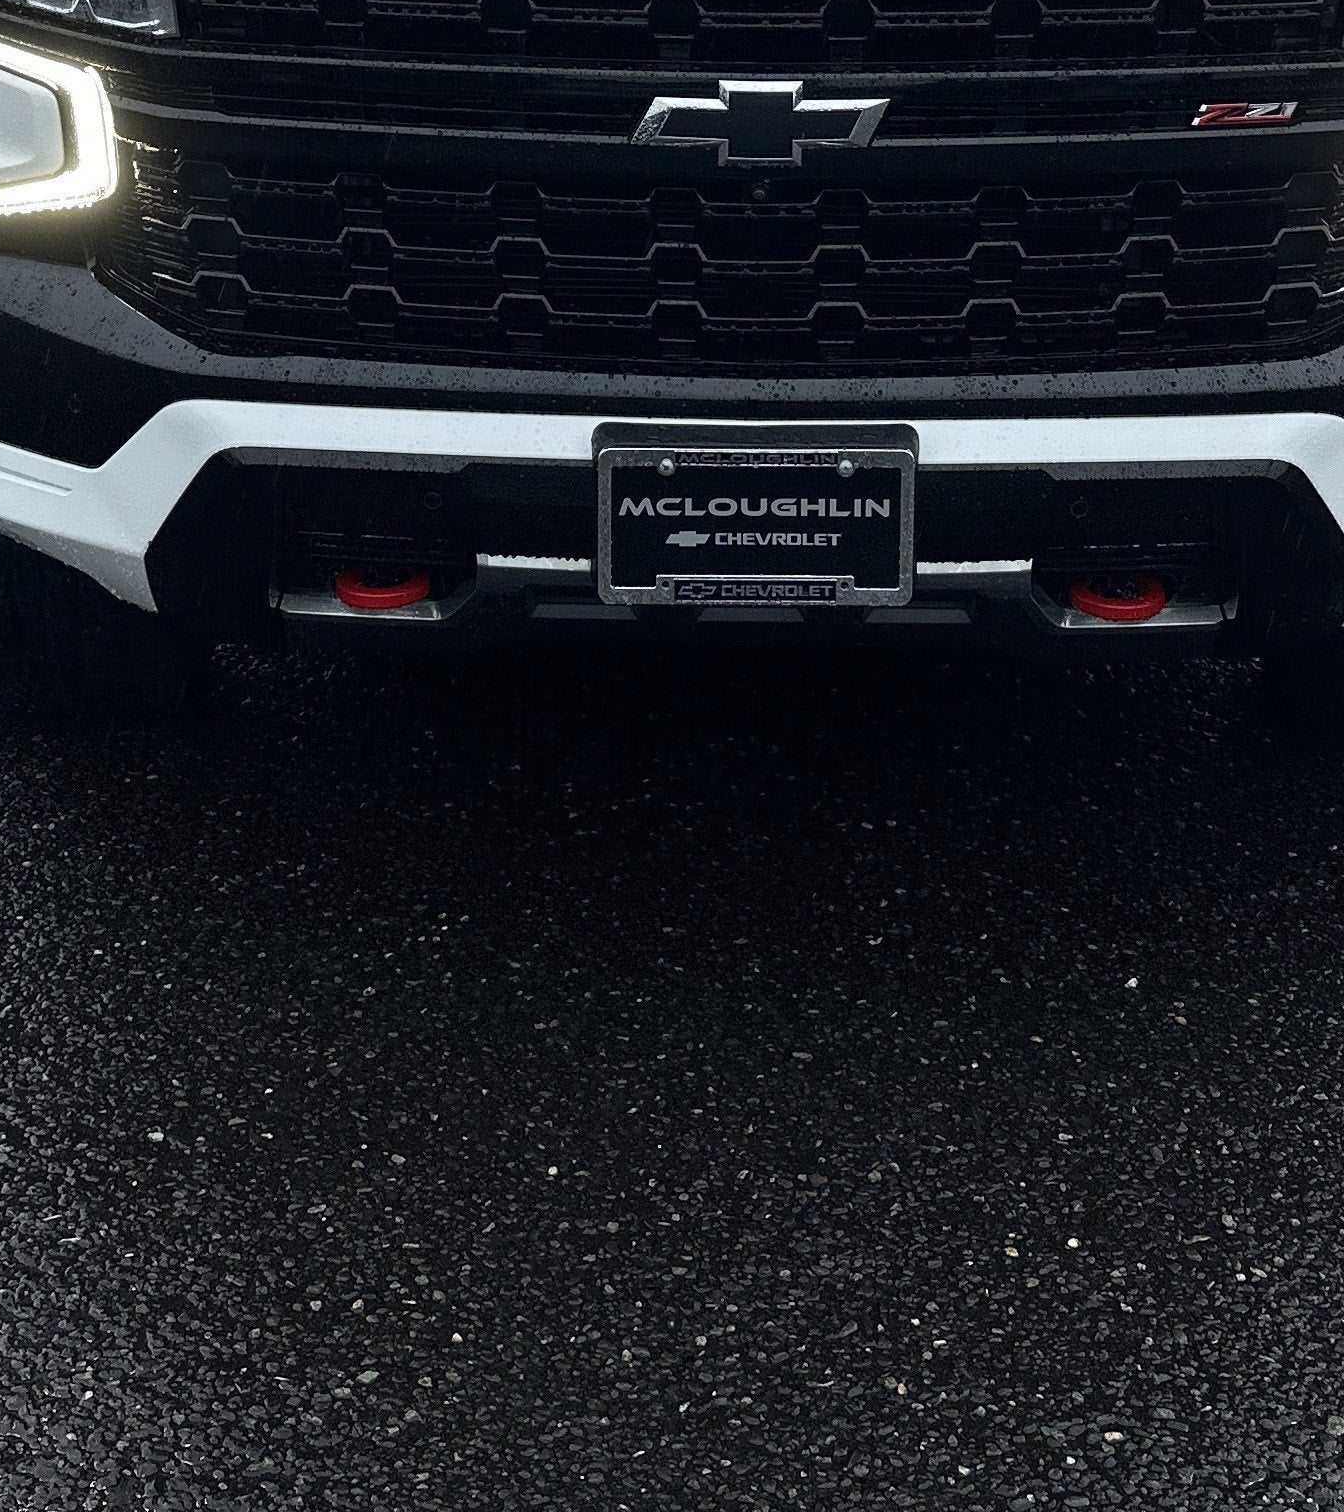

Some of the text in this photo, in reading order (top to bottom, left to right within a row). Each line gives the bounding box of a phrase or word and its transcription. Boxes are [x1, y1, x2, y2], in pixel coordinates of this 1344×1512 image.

[678, 453, 836, 464] MCLOUGHLIN
[618, 497, 890, 518] MCLOUGHLIN
[715, 532, 842, 546] CHEVROLET
[721, 584, 833, 598] CHEVROLET
